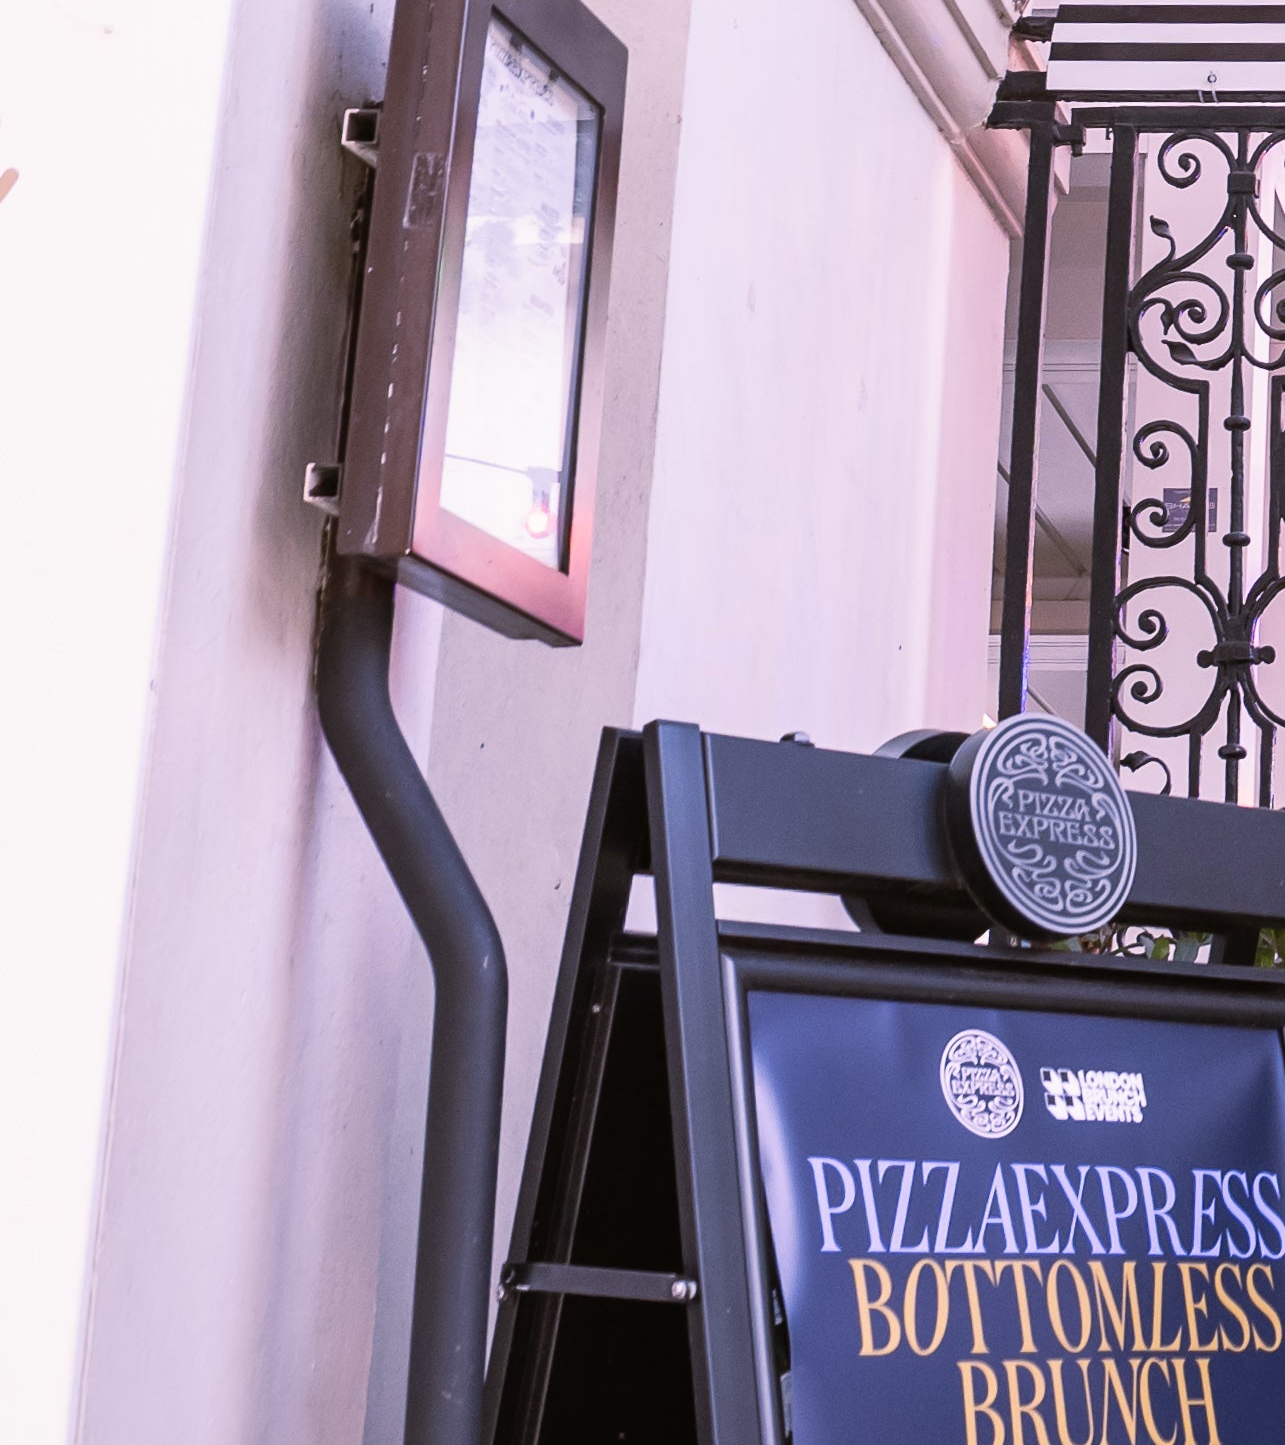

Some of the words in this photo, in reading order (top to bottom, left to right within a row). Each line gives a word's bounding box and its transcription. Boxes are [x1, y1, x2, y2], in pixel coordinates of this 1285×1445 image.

[1017, 789, 1090, 821] PIZZA
[999, 811, 1115, 849] EXPRESS
[1078, 1070, 1144, 1090] LONDON
[1081, 1087, 1147, 1107] BRUNCH
[1086, 1105, 1144, 1123] EVENTS
[849, 1258, 1283, 1356] BOTTOMLESS
